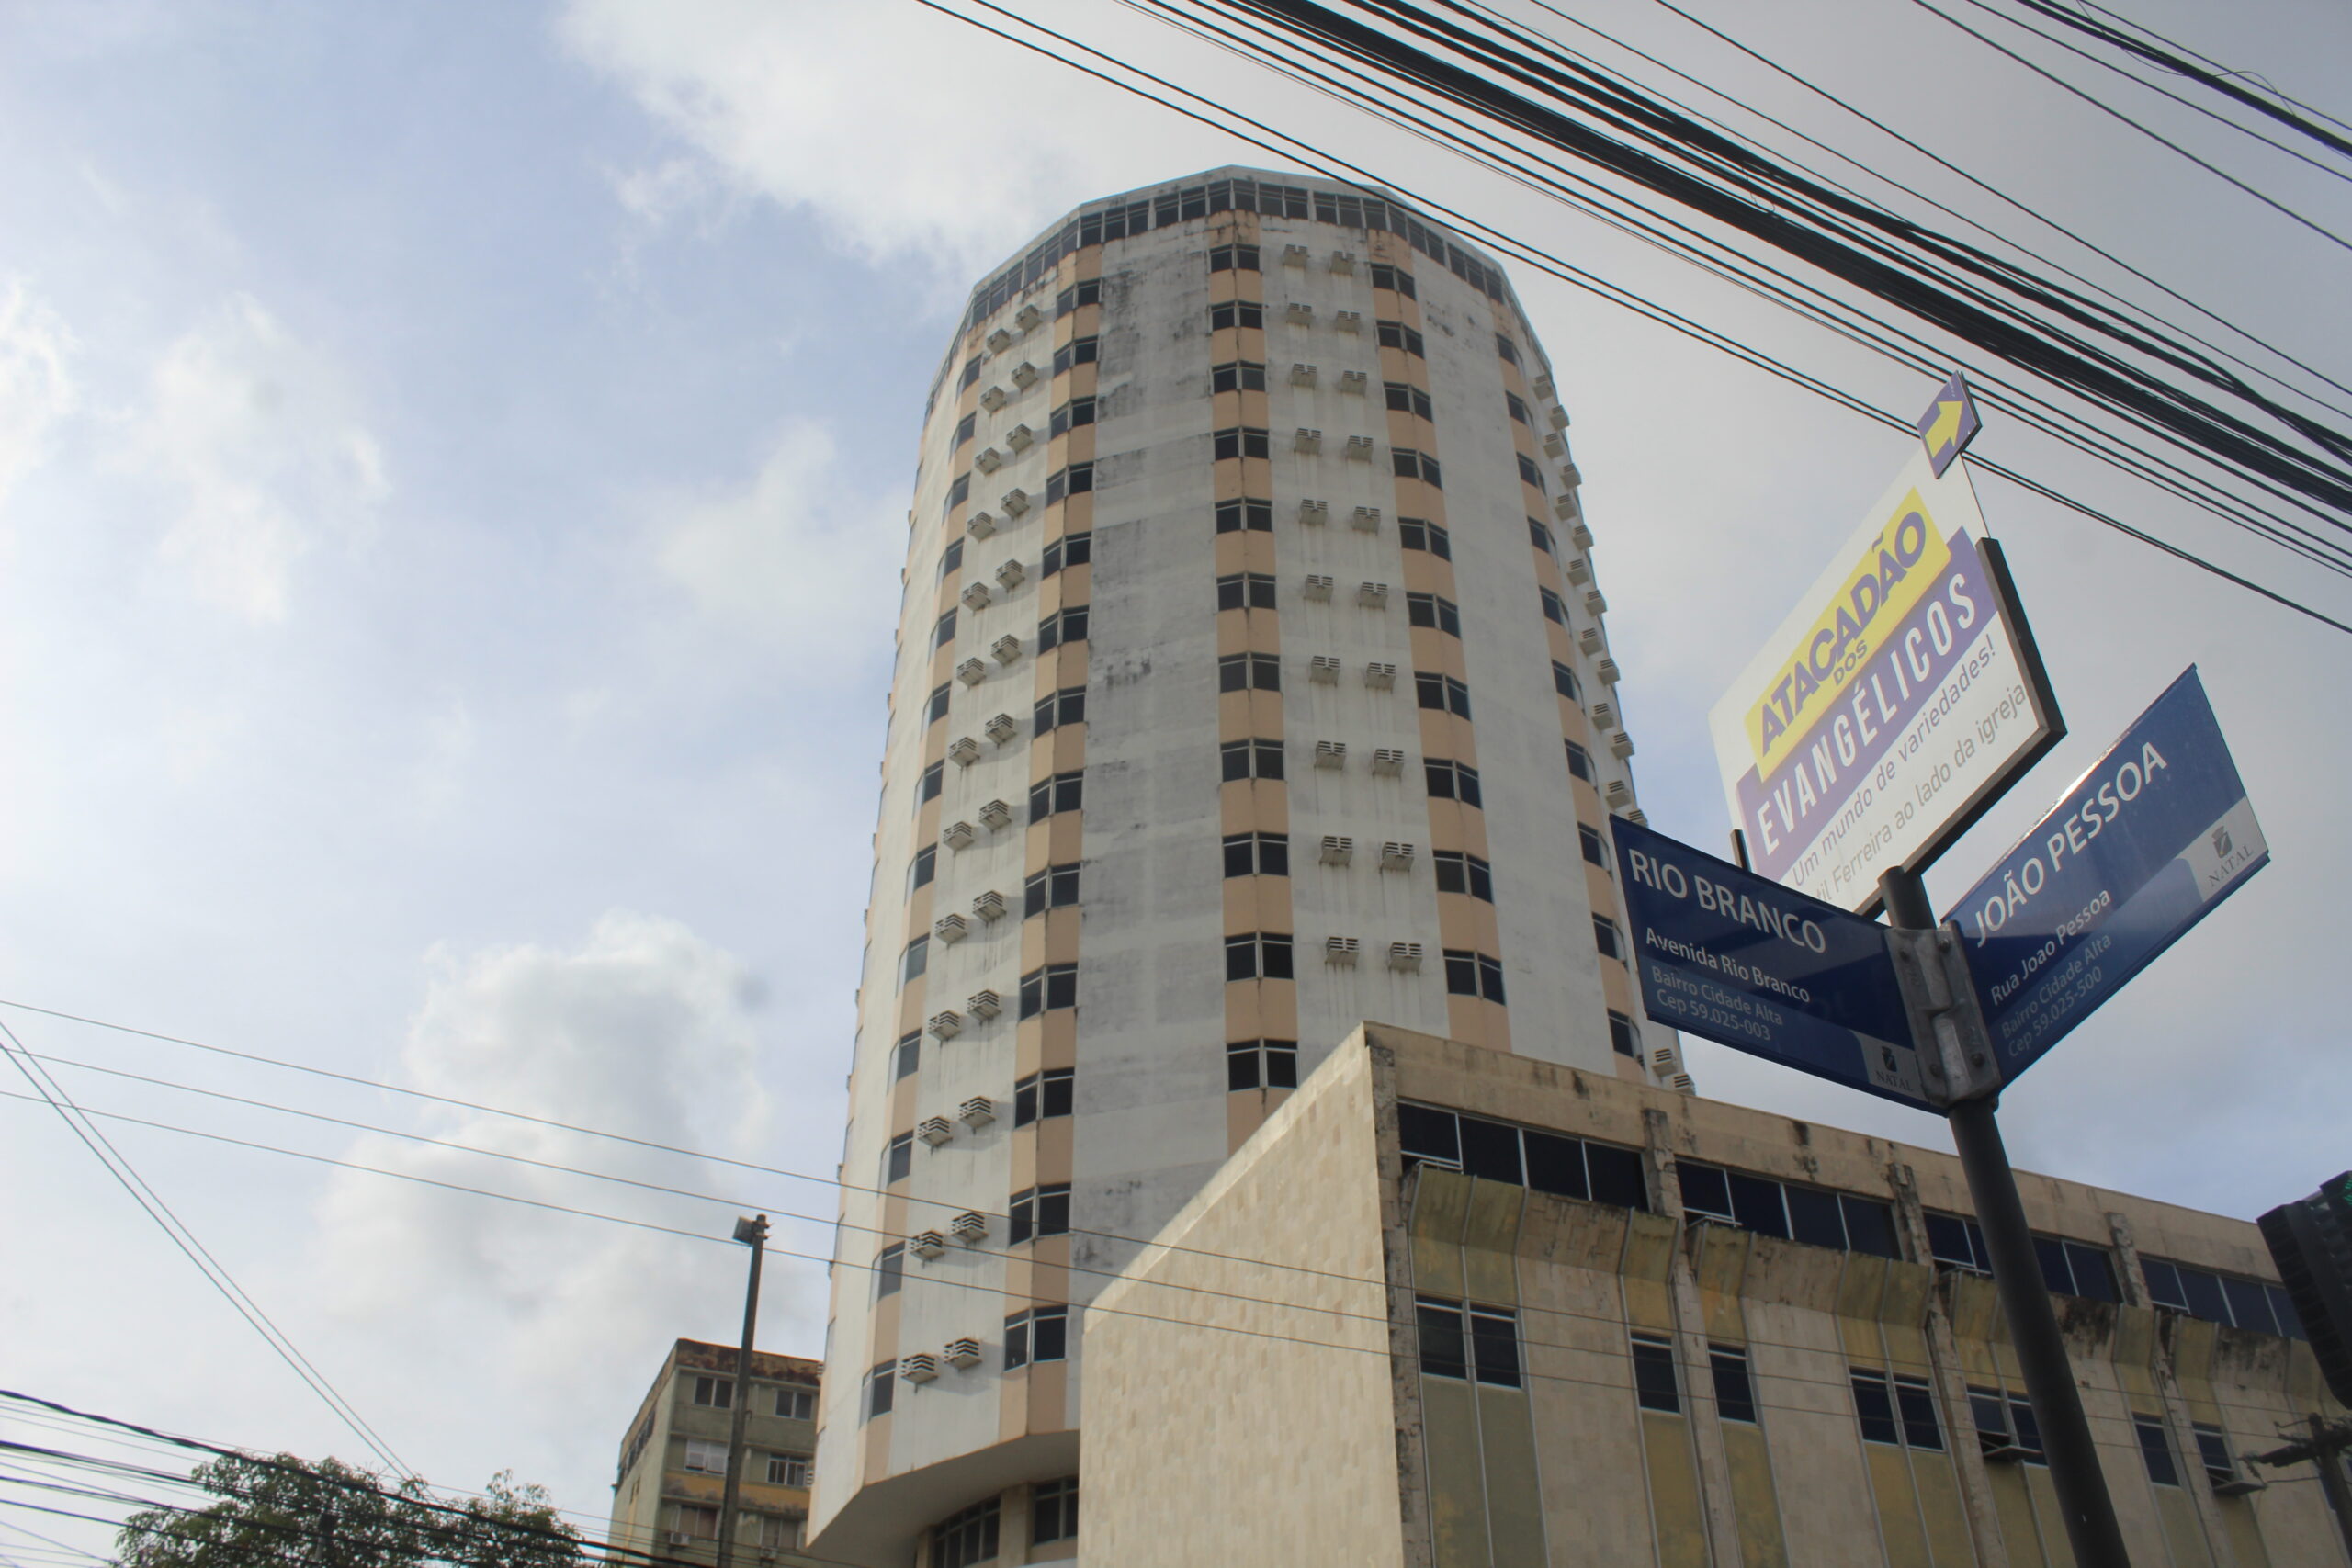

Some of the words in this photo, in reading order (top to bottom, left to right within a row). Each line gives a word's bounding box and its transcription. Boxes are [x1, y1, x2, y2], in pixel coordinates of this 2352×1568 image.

[1762, 512, 1927, 757] ATACADÃO
[1833, 640, 1868, 686] DOS
[1757, 573, 1975, 856] EVANGÉLICOS
[1792, 852, 1820, 886] Um
[1822, 786, 1872, 855] mundo
[1876, 761, 1895, 792] de
[1898, 633, 1996, 762] variedades!
[1832, 824, 1893, 893] Ferreira
[1894, 801, 1914, 829] ao
[1915, 762, 1951, 807] lado
[1954, 739, 1975, 768] da
[1975, 684, 2027, 745] igreja
[1975, 857, 2044, 947] JOÃO
[2046, 741, 2167, 872] PESSOA
[2208, 845, 2254, 887] NATAL
[1628, 848, 1688, 899] RIO
[1693, 875, 1826, 953] BRANCO
[1990, 974, 2020, 1006] Rua
[2021, 941, 2056, 980] Joao
[2055, 890, 2111, 945] Pessoa
[1645, 927, 1718, 970] Avenida
[1720, 954, 1749, 981] Rio
[1752, 967, 1810, 1003] Branco
[1652, 966, 1698, 996] Bairro
[1702, 984, 1752, 1015] Cidade
[1755, 1003, 1783, 1025] Alta
[1657, 989, 1687, 1015] Cep
[1690, 1001, 1771, 1041] 59.025-003
[2001, 1000, 2038, 1039] Bairro
[2039, 960, 2083, 1004] Cidade
[2085, 935, 2111, 963] Alta
[2009, 1032, 2032, 1057] Cep
[2033, 966, 2102, 1036] 59.025-500
[1875, 1070, 1914, 1091] NATAL
